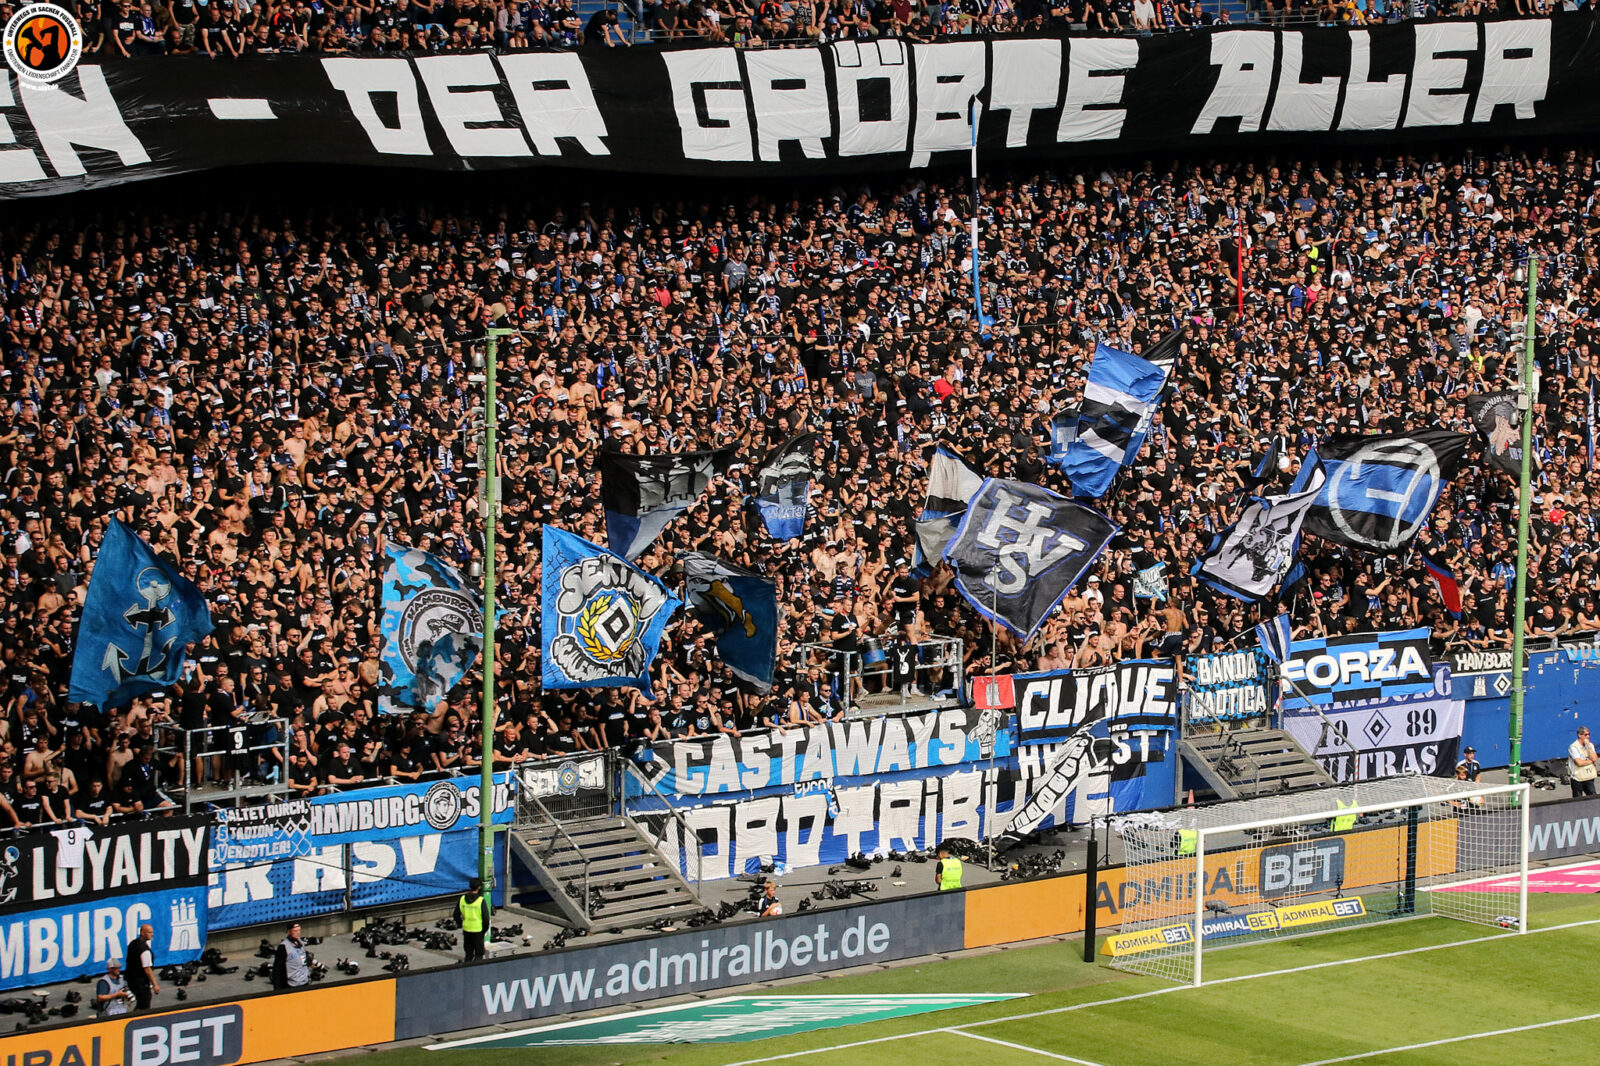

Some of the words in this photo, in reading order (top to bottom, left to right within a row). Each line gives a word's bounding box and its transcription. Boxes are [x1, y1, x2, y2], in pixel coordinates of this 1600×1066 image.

[320, 53, 610, 156] DER
[1190, 19, 1552, 134] ALLER
[1197, 652, 1258, 685] BANDA
[1280, 646, 1430, 692] FORZA
[1454, 651, 1514, 672] HAMBUR
[233, 731, 244, 749] 9
[1406, 708, 1437, 737] 89
[673, 710, 967, 795] CASTAWAYS
[216, 806, 265, 822] HALTET
[311, 793, 420, 836] HAMBURG
[465, 784, 509, 817] SD
[67, 829, 76, 846] 9
[32, 826, 206, 901] LOYALTY
[291, 833, 442, 895] HSV
[482, 915, 890, 1015] www.admiralbet.de
